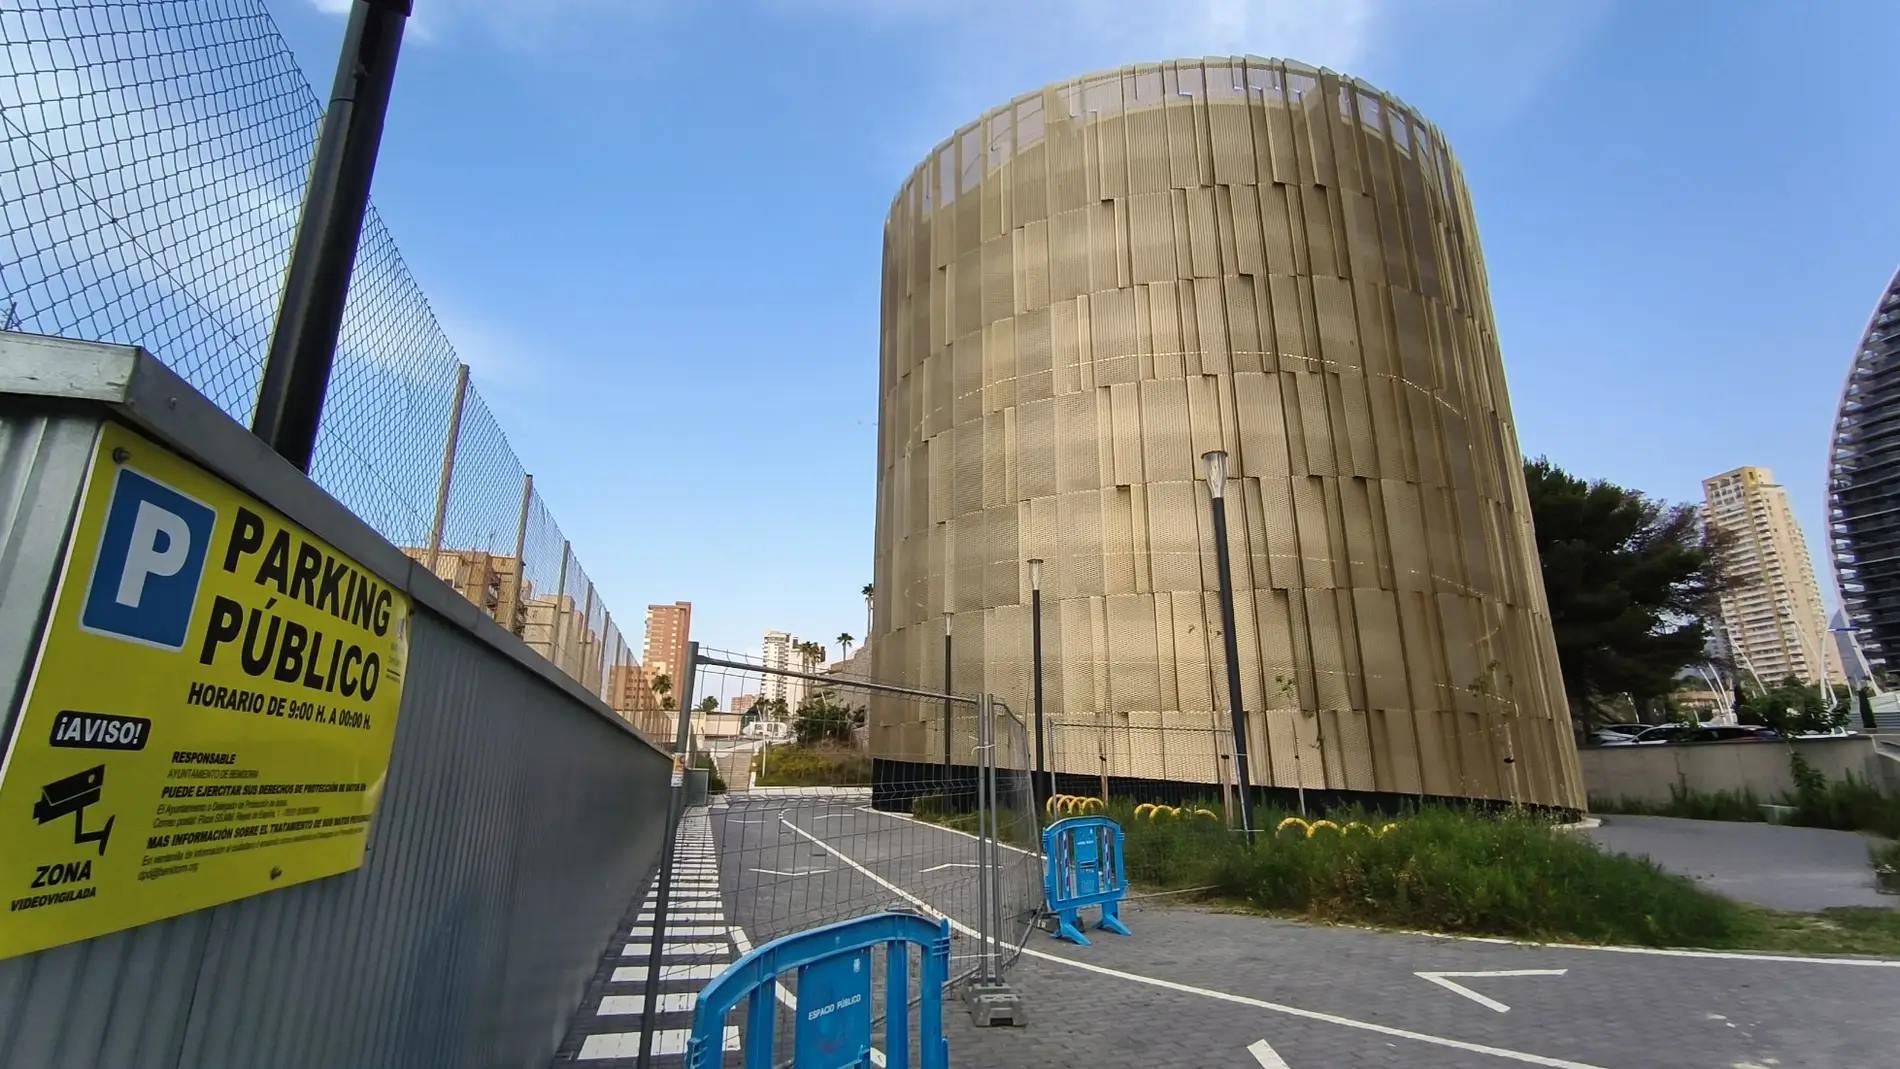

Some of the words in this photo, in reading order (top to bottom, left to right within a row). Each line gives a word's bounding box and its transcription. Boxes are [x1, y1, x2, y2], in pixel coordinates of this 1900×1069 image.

[115, 499, 191, 608] P
[223, 506, 392, 638] PARKING
[199, 595, 380, 702] PÚBLICO
[187, 682, 265, 714] HORARIO
[266, 696, 287, 717] DE
[288, 700, 313, 721] 9:00
[315, 705, 326, 723] H.
[328, 708, 336, 724] A
[339, 709, 363, 729] 00:00
[362, 714, 371, 730] H.
[56, 716, 142, 745] ¡AVISO!
[172, 751, 236, 764] RESPONSABLE
[167, 769, 219, 779] AYUNTAMIENTO
[220, 770, 230, 779] DE
[161, 786, 195, 799] PUEDE
[196, 785, 242, 797] EJERCITAR
[242, 785, 258, 795] SUS
[258, 784, 294, 795] DERECHOS
[294, 784, 303, 794] DE
[304, 782, 339, 793] PROTECCIÓN
[147, 835, 170, 849] MAS
[171, 826, 233, 846] INFORMACIÓN
[234, 825, 259, 838] SOBRE
[260, 824, 269, 835] EL
[270, 820, 313, 833] TRATAMIENTO
[31, 860, 91, 888] ZONA
[10, 887, 96, 911] VIDEOVIGILADA
[808, 1003, 835, 1021] ESPACIO
[836, 994, 861, 1011] PÚBLICO
